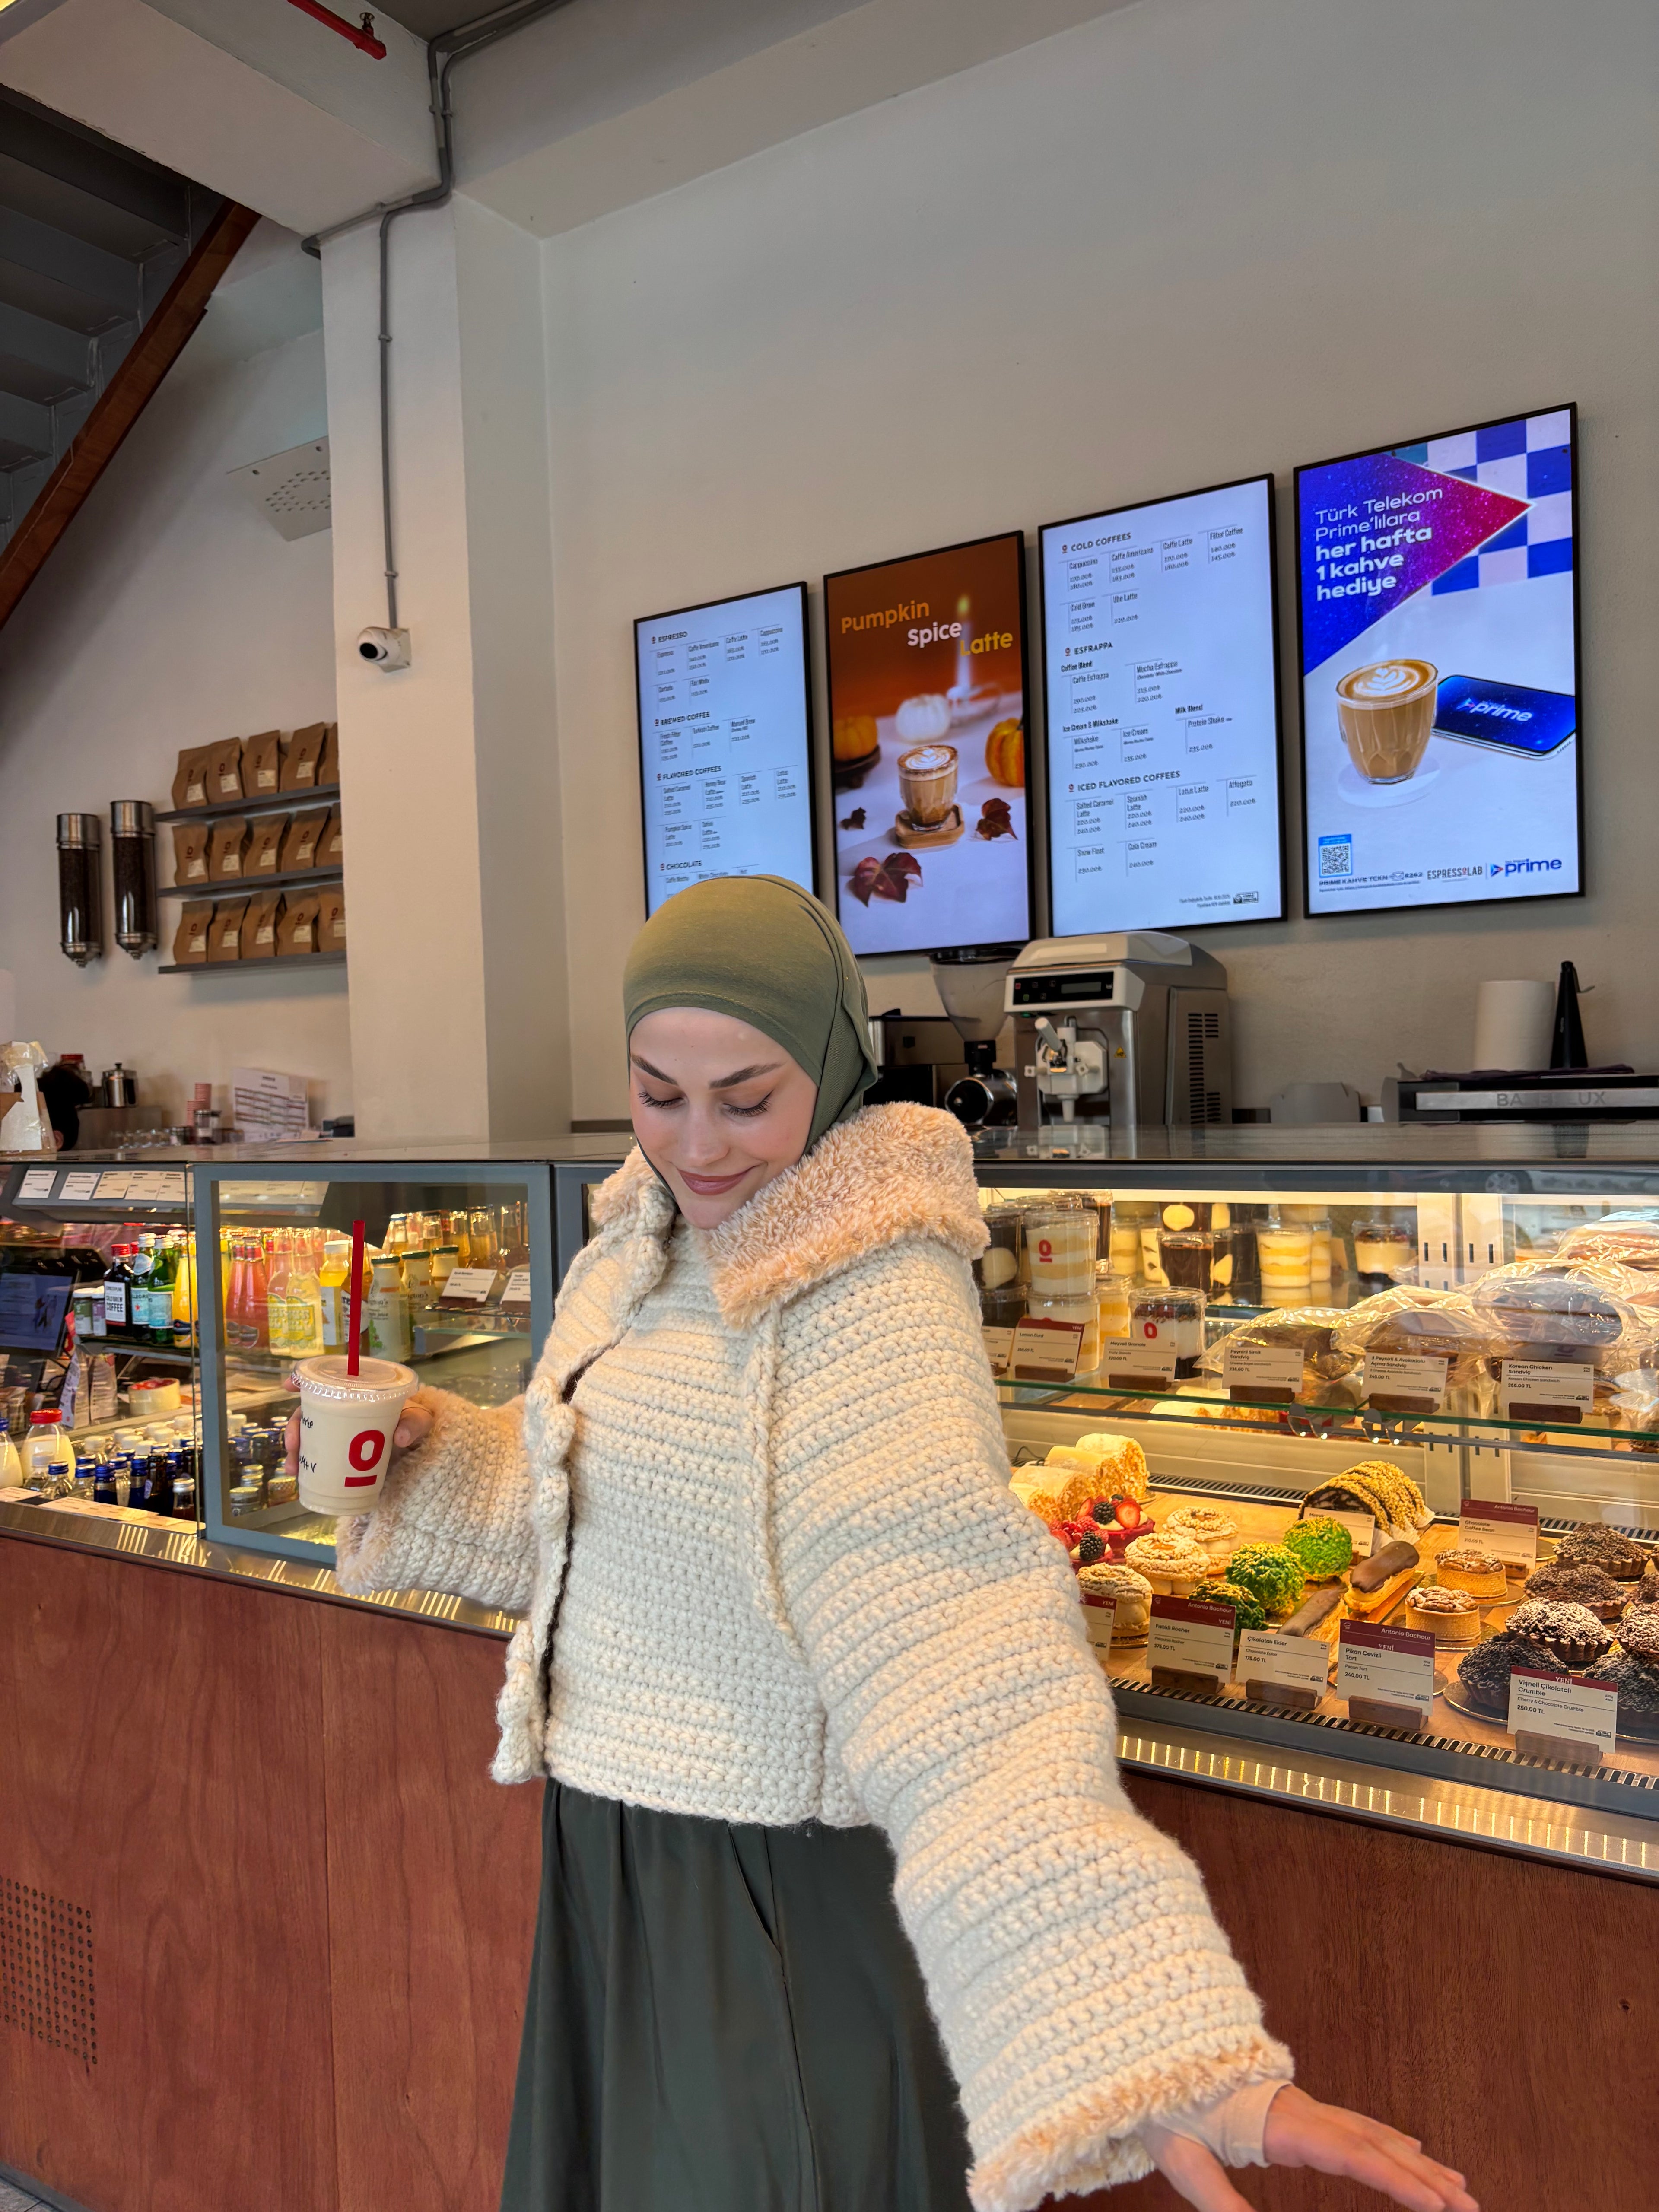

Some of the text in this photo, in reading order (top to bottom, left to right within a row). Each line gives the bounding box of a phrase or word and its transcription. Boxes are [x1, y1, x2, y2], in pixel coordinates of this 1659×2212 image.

[1315, 488, 1443, 524] Türk Telekom
[1071, 532, 1131, 552] COLD COFFEES
[1178, 538, 1193, 547] Latte
[1316, 527, 1432, 561] her hafta
[1316, 553, 1404, 580] 1 kahve
[1316, 575, 1397, 601] hediye
[1124, 593, 1138, 601] Latte
[841, 600, 929, 634] Pumpkin
[658, 631, 688, 643] ESPRESSO
[960, 632, 1013, 657] Latte
[1074, 642, 1113, 655] ESFRAPPA
[1175, 704, 1203, 715] Milk Blend
[1470, 700, 1533, 722] prime
[661, 711, 710, 726] BREWED COFFEE
[663, 766, 721, 780] FLAVORED COFFEES
[1078, 771, 1180, 791] ICED FLAVORED COFFEES
[1194, 785, 1209, 793] Latte
[1093, 798, 1113, 807] Caramel
[1127, 794, 1147, 803] Spanish
[666, 860, 702, 870] CHOCOLATE
[1505, 858, 1562, 877] prime
[1188, 1602, 1232, 1614] Antonio Bachour
[1247, 1636, 1273, 1644] Çikolatalı
[1381, 1628, 1431, 1640] Antonio Bachour
[1378, 1643, 1394, 1651] YENİ
[1555, 1676, 1573, 1684] YENİ
[1518, 1680, 1572, 1694] Vişneli Çikolatalı
[1518, 1687, 1546, 1696] Crumble
[1517, 1704, 1537, 1713] 250.00
[1538, 1700, 1563, 1708] Chocolate
